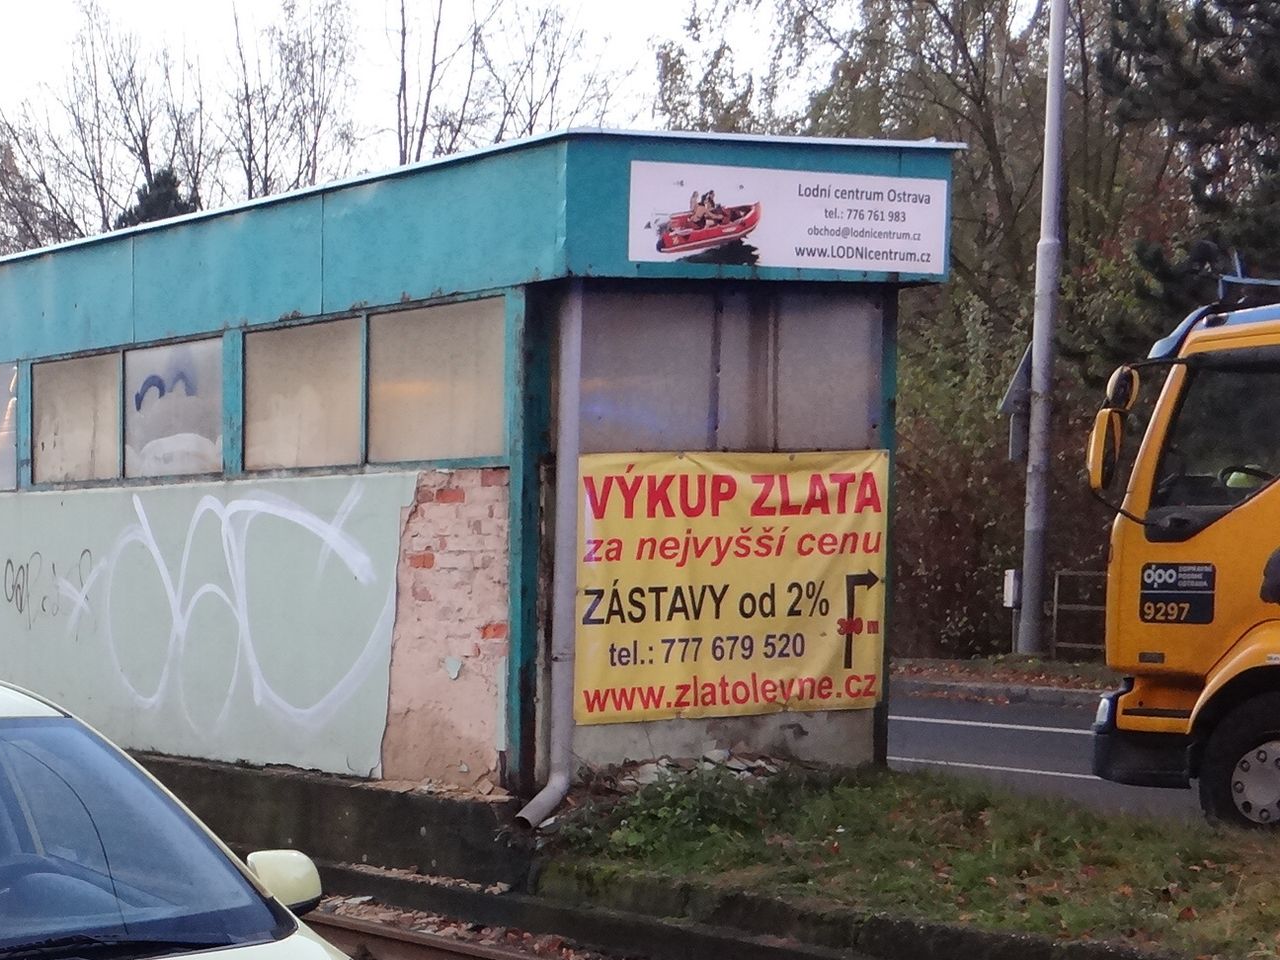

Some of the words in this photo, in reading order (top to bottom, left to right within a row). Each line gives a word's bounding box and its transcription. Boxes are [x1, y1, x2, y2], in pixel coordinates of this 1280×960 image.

[798, 184, 831, 199] Lodní
[834, 188, 884, 202] centrum
[887, 189, 931, 205] Ostrava
[824, 208, 844, 220] tel.:
[847, 209, 865, 221] 776
[868, 210, 886, 222] 761
[888, 211, 906, 222] 983
[807, 226, 921, 241] obchod@lodnicentrum.cz
[794, 245, 931, 263] www.LODNIcentrum.cz
[583, 464, 738, 520] VÝKUP
[750, 471, 882, 517] ZLATA
[582, 536, 623, 563] za
[635, 526, 789, 567] nejvyšší
[796, 531, 882, 556] cenu
[582, 579, 730, 626] ZÁSTAVY
[738, 582, 777, 619] od
[786, 580, 830, 617] 2%
[1143, 602, 1190, 621] 9297
[609, 640, 654, 667] tel.:
[660, 637, 703, 664] 777
[711, 635, 754, 662] 679
[763, 633, 805, 659] 520
[582, 672, 878, 713] www.zlatolevne.cz
